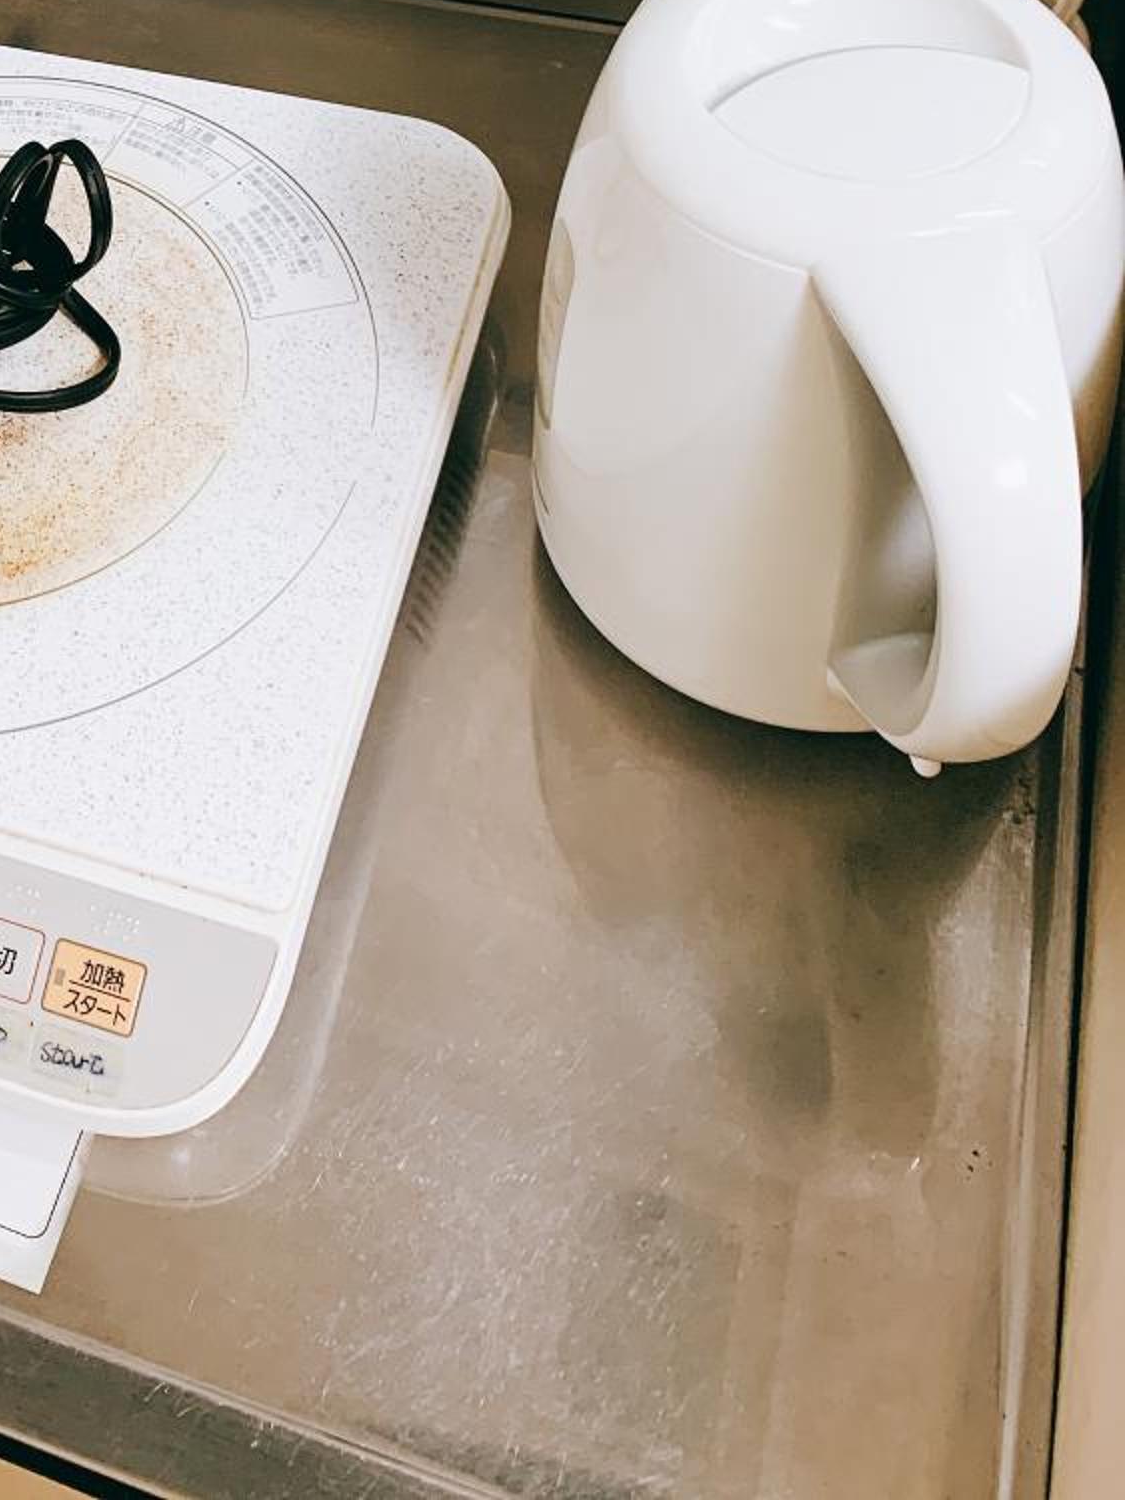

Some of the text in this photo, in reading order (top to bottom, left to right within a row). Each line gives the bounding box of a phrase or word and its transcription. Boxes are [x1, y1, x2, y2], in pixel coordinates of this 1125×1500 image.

[79, 959, 126, 995] 加熱
[63, 989, 127, 1026] スタート
